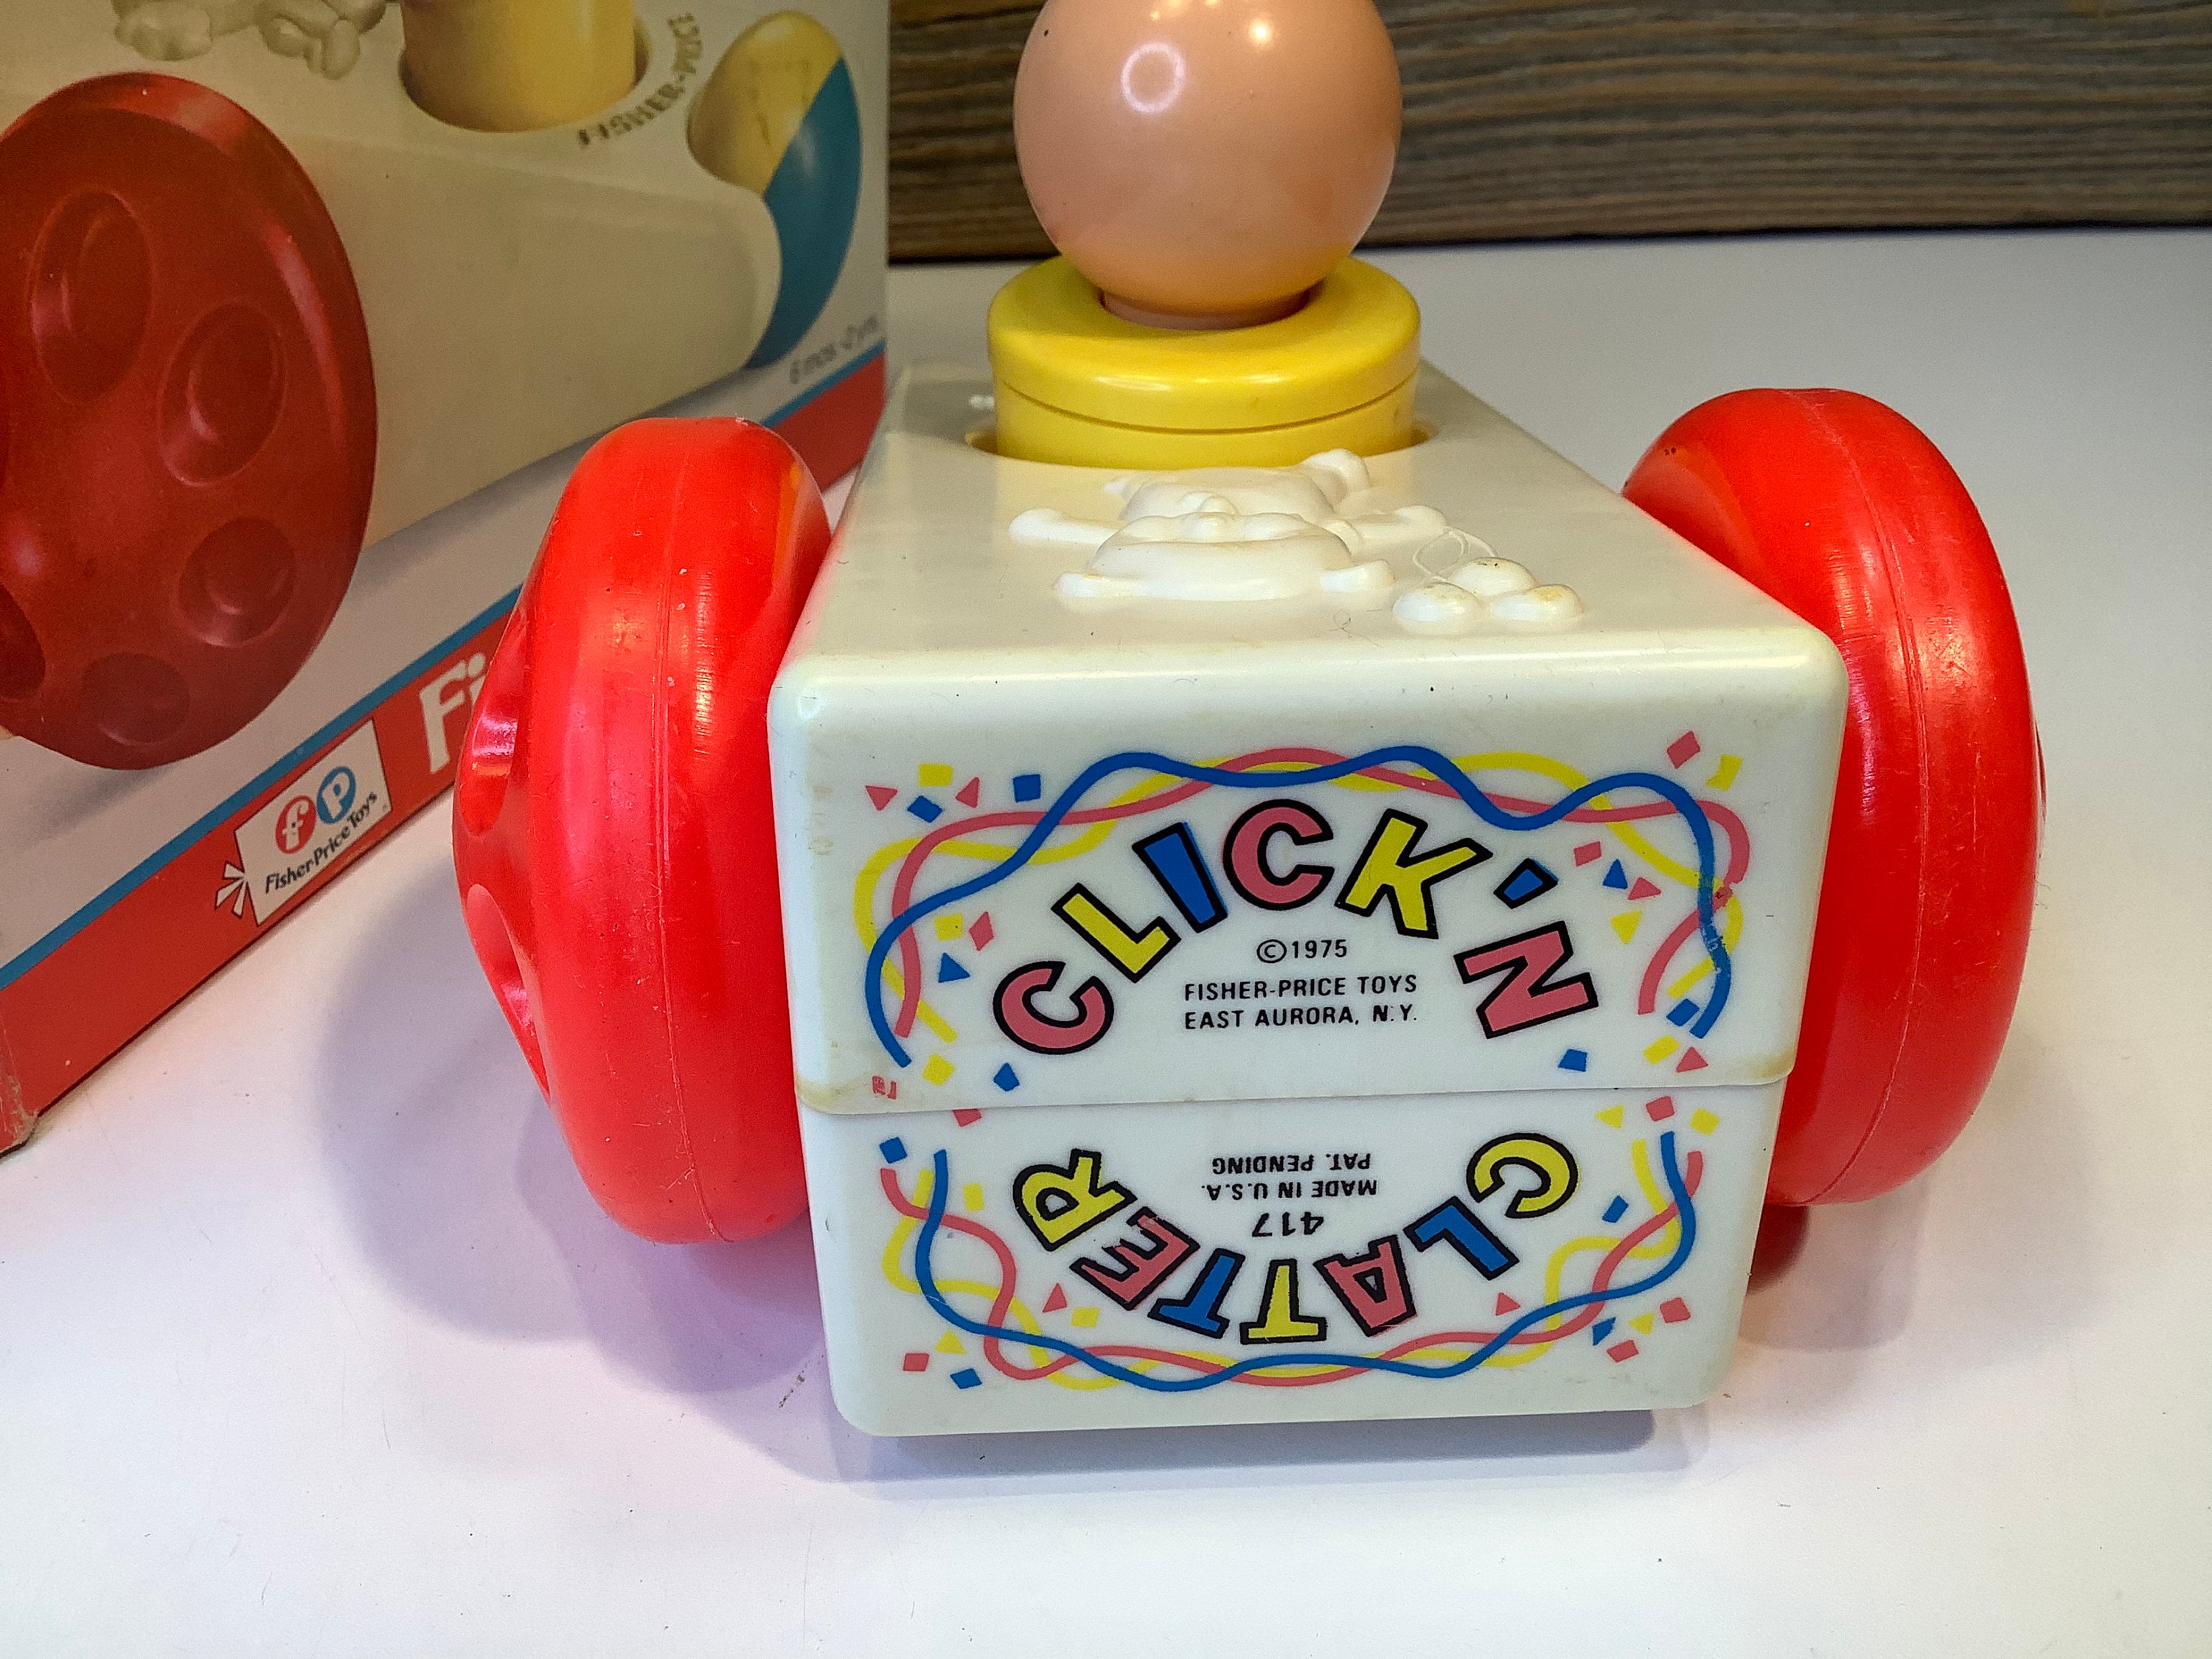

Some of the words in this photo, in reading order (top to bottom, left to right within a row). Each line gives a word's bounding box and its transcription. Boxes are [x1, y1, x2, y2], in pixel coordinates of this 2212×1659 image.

[347, 791, 378, 830] Toys
[1184, 977, 1346, 1001] FISHER-PRICE
[1357, 974, 1417, 995] TOYS
[1184, 1009, 1245, 1030] EAST
[1255, 1006, 1360, 1027] AURORA,
[1211, 1154, 1315, 1175] PENDING
[1326, 1152, 1371, 1171] PAT.
[1200, 1182, 1268, 1201] U.S.A.
[1277, 1181, 1302, 1199] IN
[1311, 1179, 1377, 1198] MADE
[1251, 1211, 1324, 1237] 417
[1012, 1132, 1579, 1346] CLATTER
